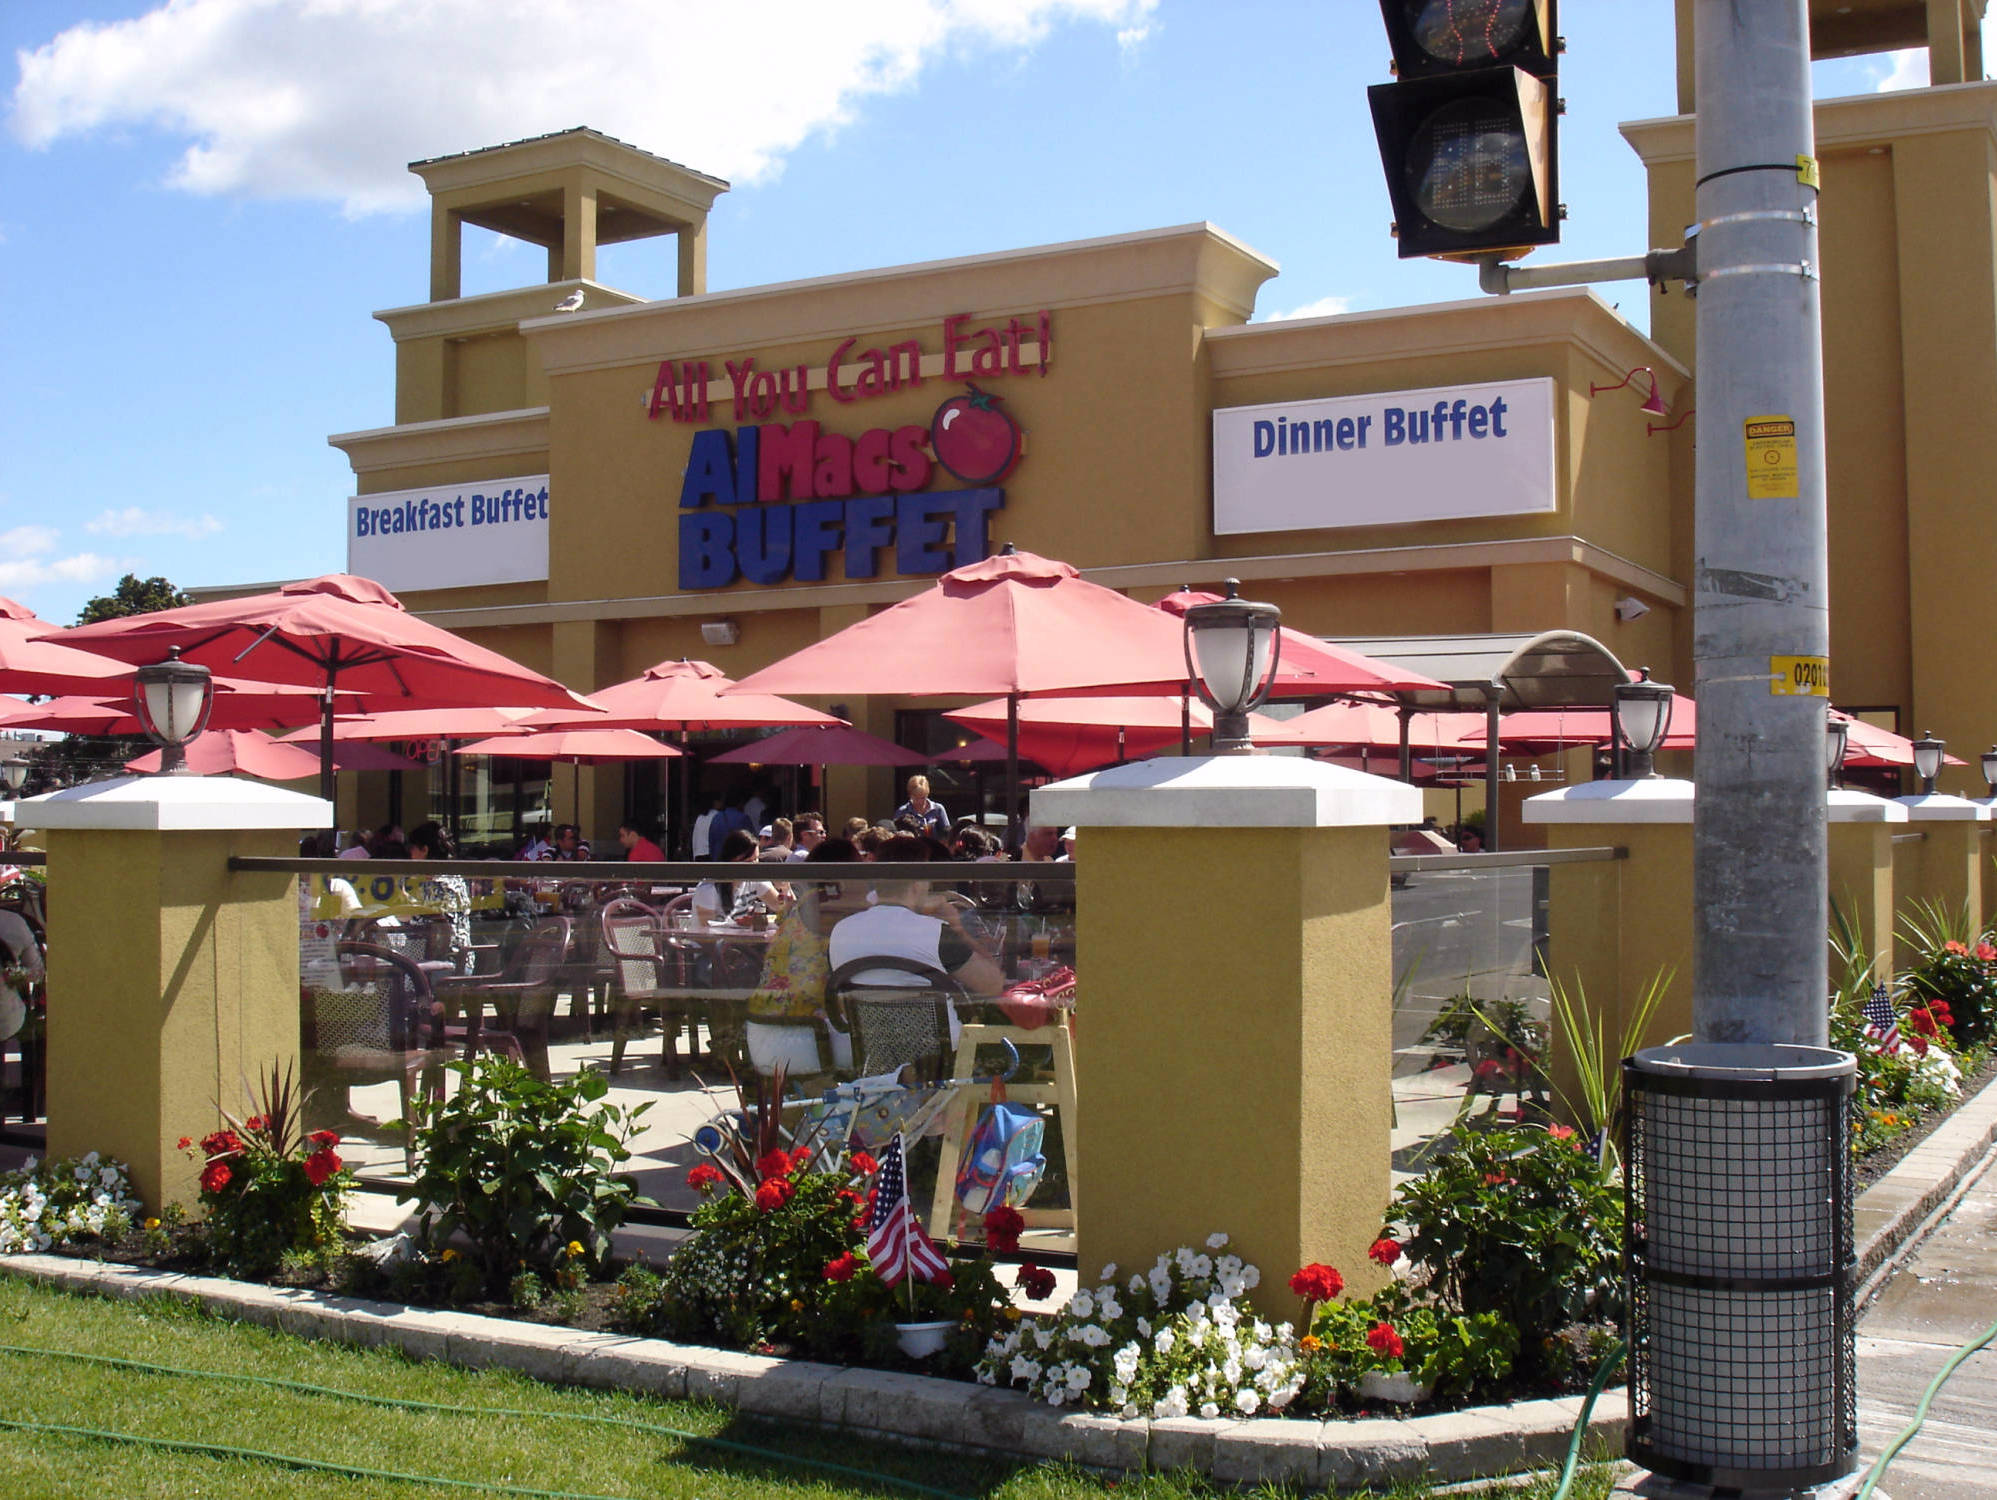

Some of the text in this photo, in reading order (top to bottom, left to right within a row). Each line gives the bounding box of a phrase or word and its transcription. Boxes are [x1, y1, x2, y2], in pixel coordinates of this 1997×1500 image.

[648, 310, 1051, 422] All You Can Eat!
[679, 420, 932, 508] AlMacs
[1253, 396, 1508, 458] Dinner Buffet
[356, 486, 549, 537] Breakfast Buffet
[678, 488, 1005, 590] BUFFET
